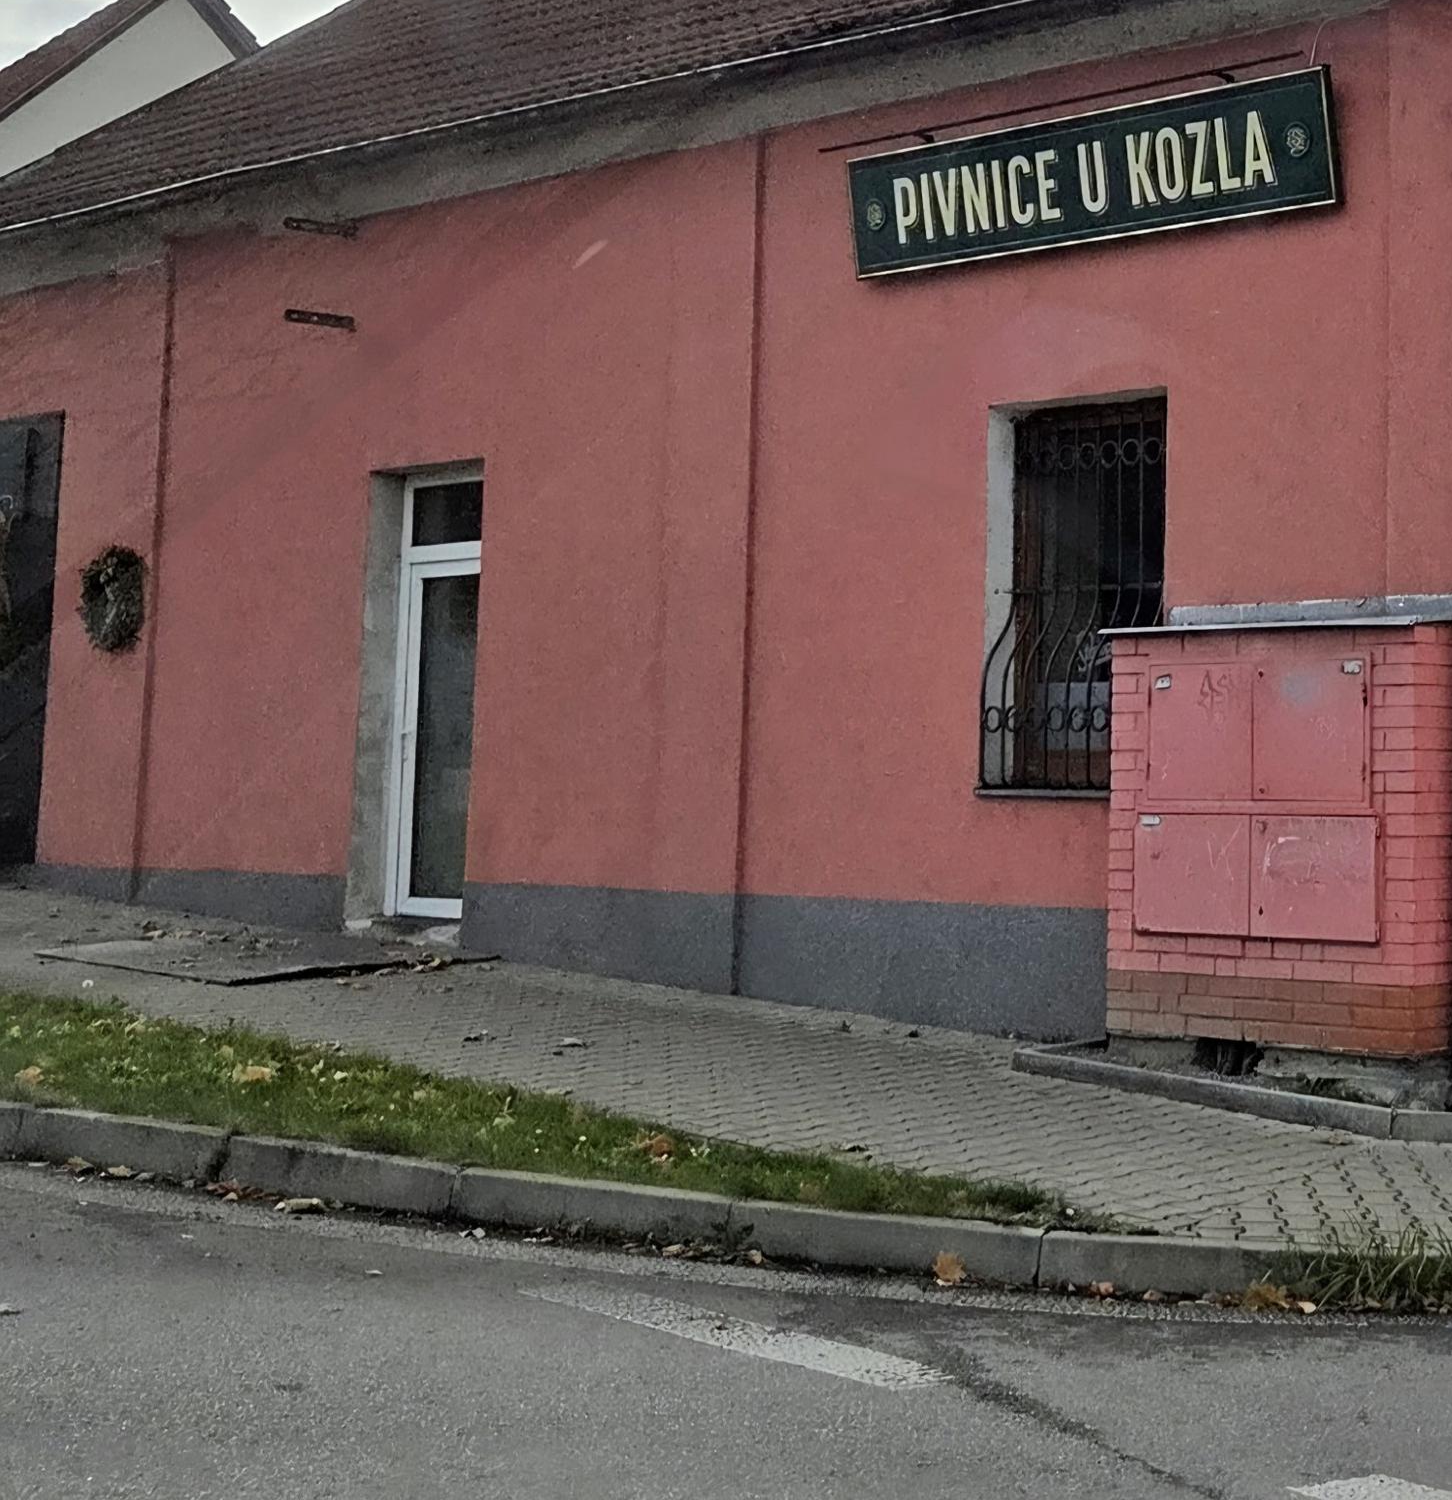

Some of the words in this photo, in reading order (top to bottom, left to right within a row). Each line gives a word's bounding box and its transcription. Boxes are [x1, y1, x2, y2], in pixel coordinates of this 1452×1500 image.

[893, 149, 1063, 245] PIVNICE
[1077, 141, 1109, 215] U
[1125, 110, 1277, 209] KOZLA
